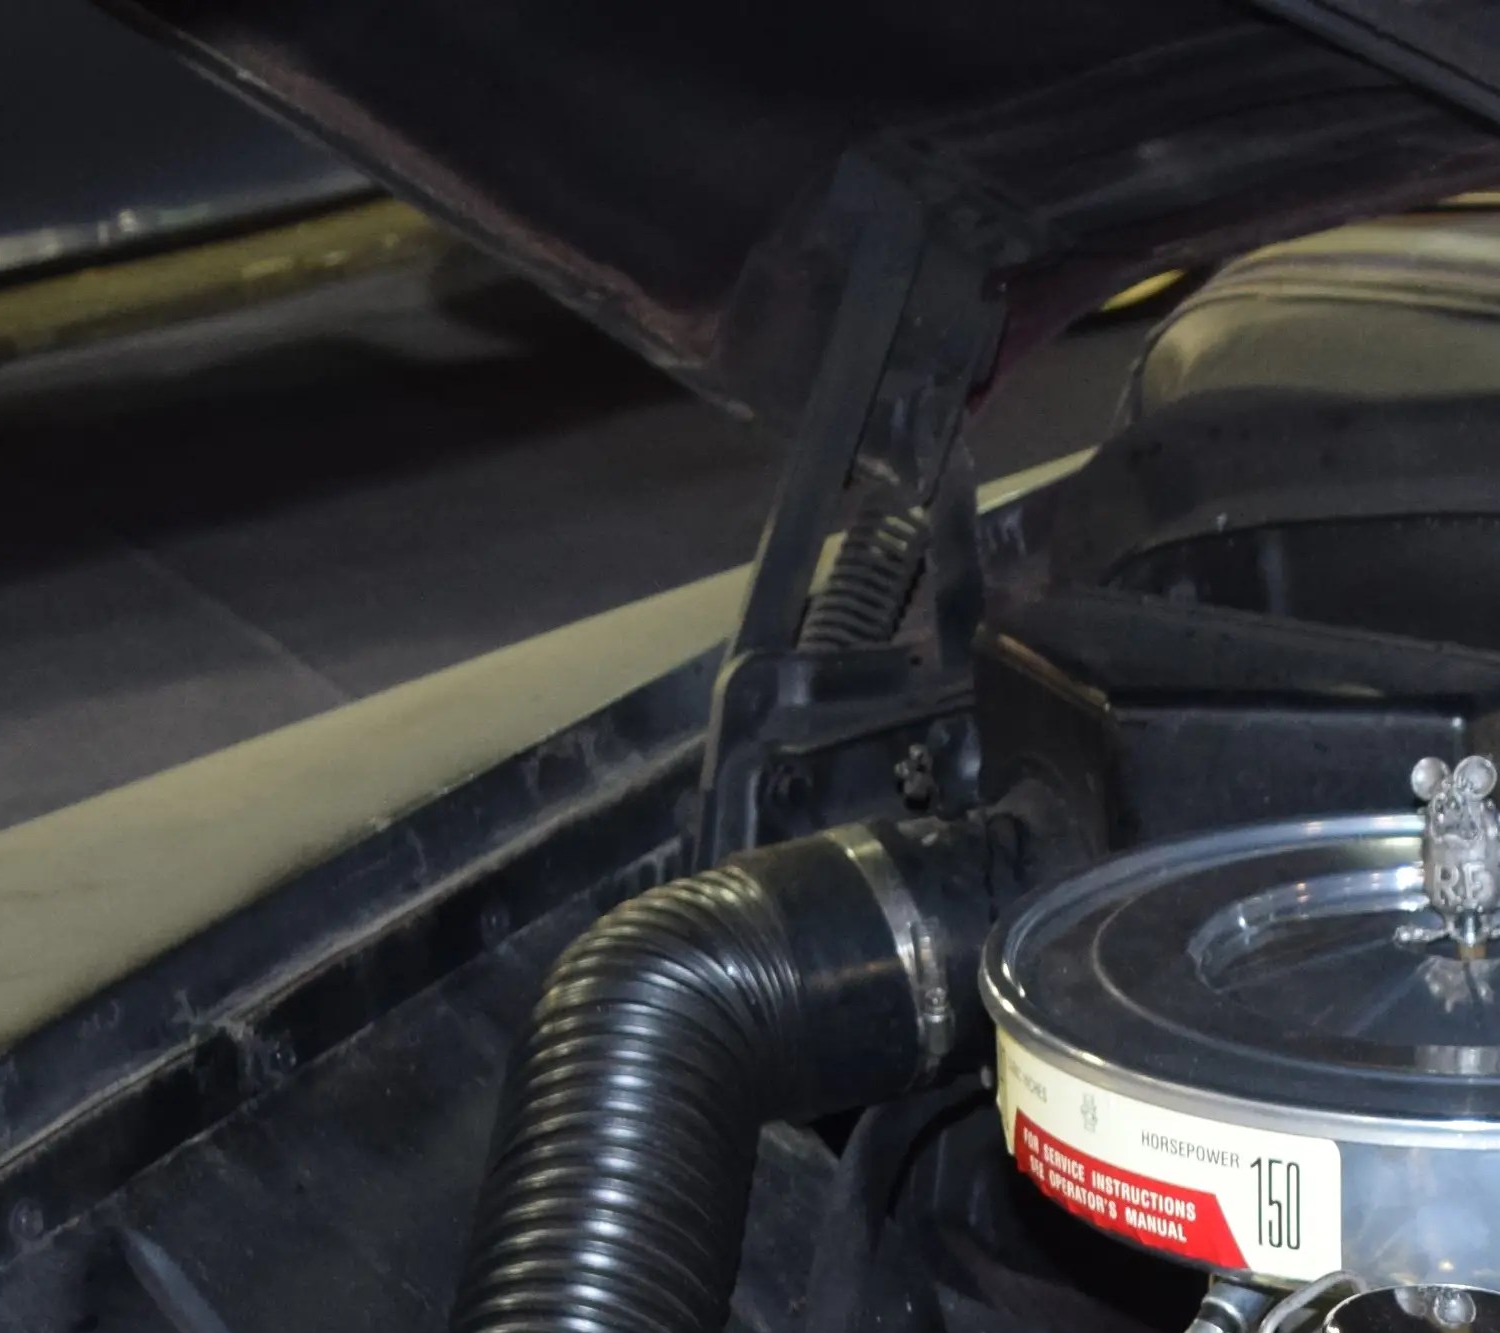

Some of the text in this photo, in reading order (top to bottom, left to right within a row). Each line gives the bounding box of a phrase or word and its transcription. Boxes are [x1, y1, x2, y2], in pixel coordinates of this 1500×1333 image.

[1023, 1127, 1196, 1222] FOR SERVICE INSTRUCTIONS
[1049, 1170, 1118, 1219] OPERATOR'S
[1124, 1207, 1188, 1243] MANUAL
[1141, 1132, 1300, 1250] HORSEPOWER 150
